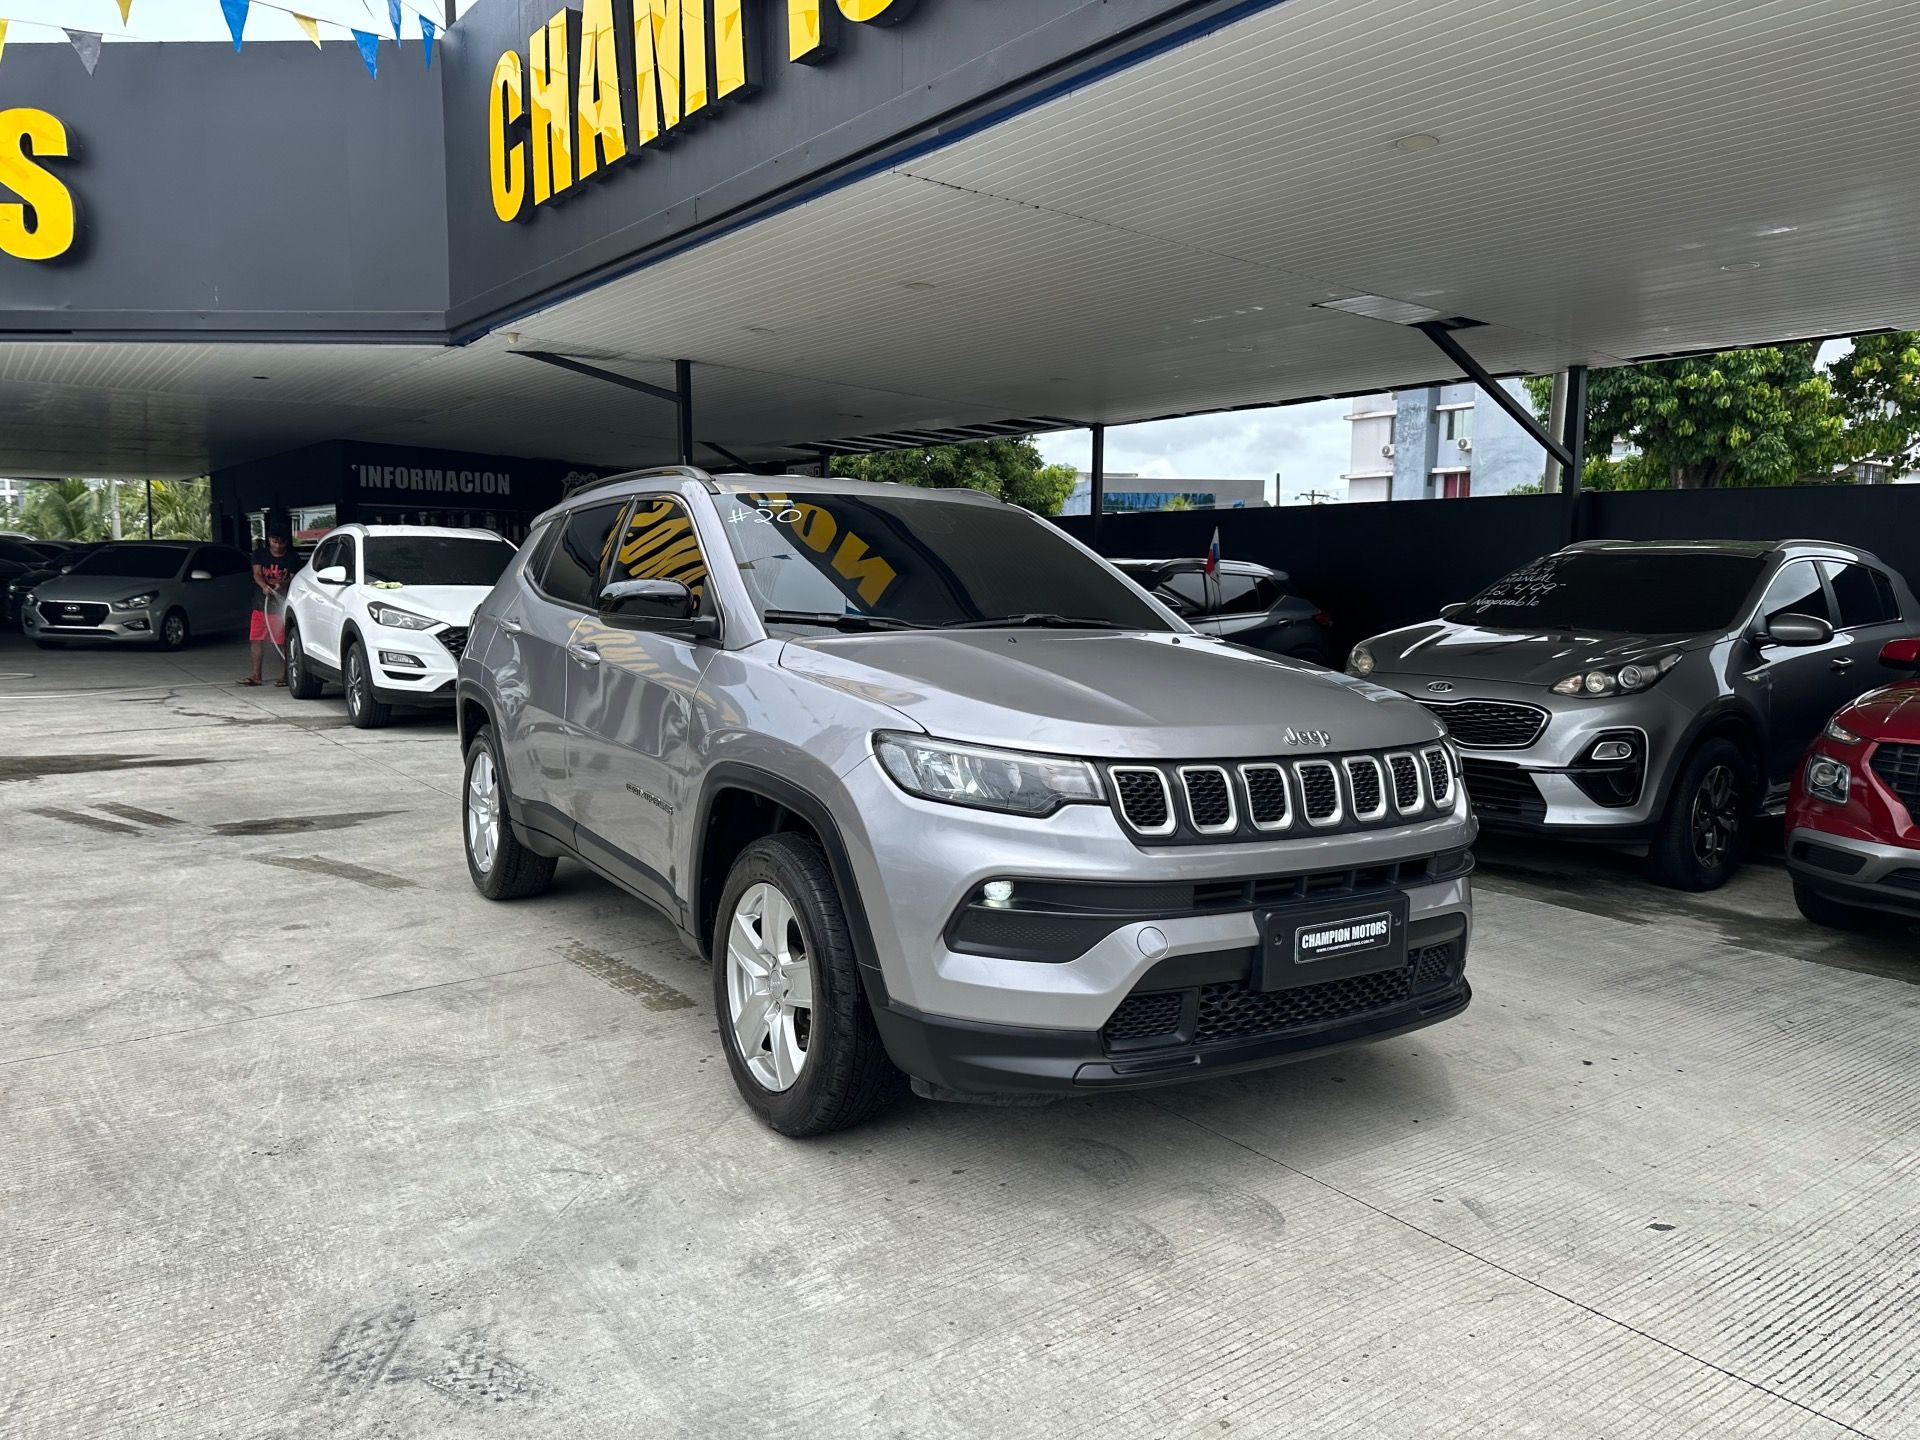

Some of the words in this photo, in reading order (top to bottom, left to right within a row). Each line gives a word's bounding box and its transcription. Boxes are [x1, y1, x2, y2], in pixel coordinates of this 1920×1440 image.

[359, 465, 511, 495] INFORMACION
[1283, 727, 1331, 748] Jeep
[1302, 928, 1351, 949] CHAMPION
[1351, 920, 1388, 941] MOTORS
